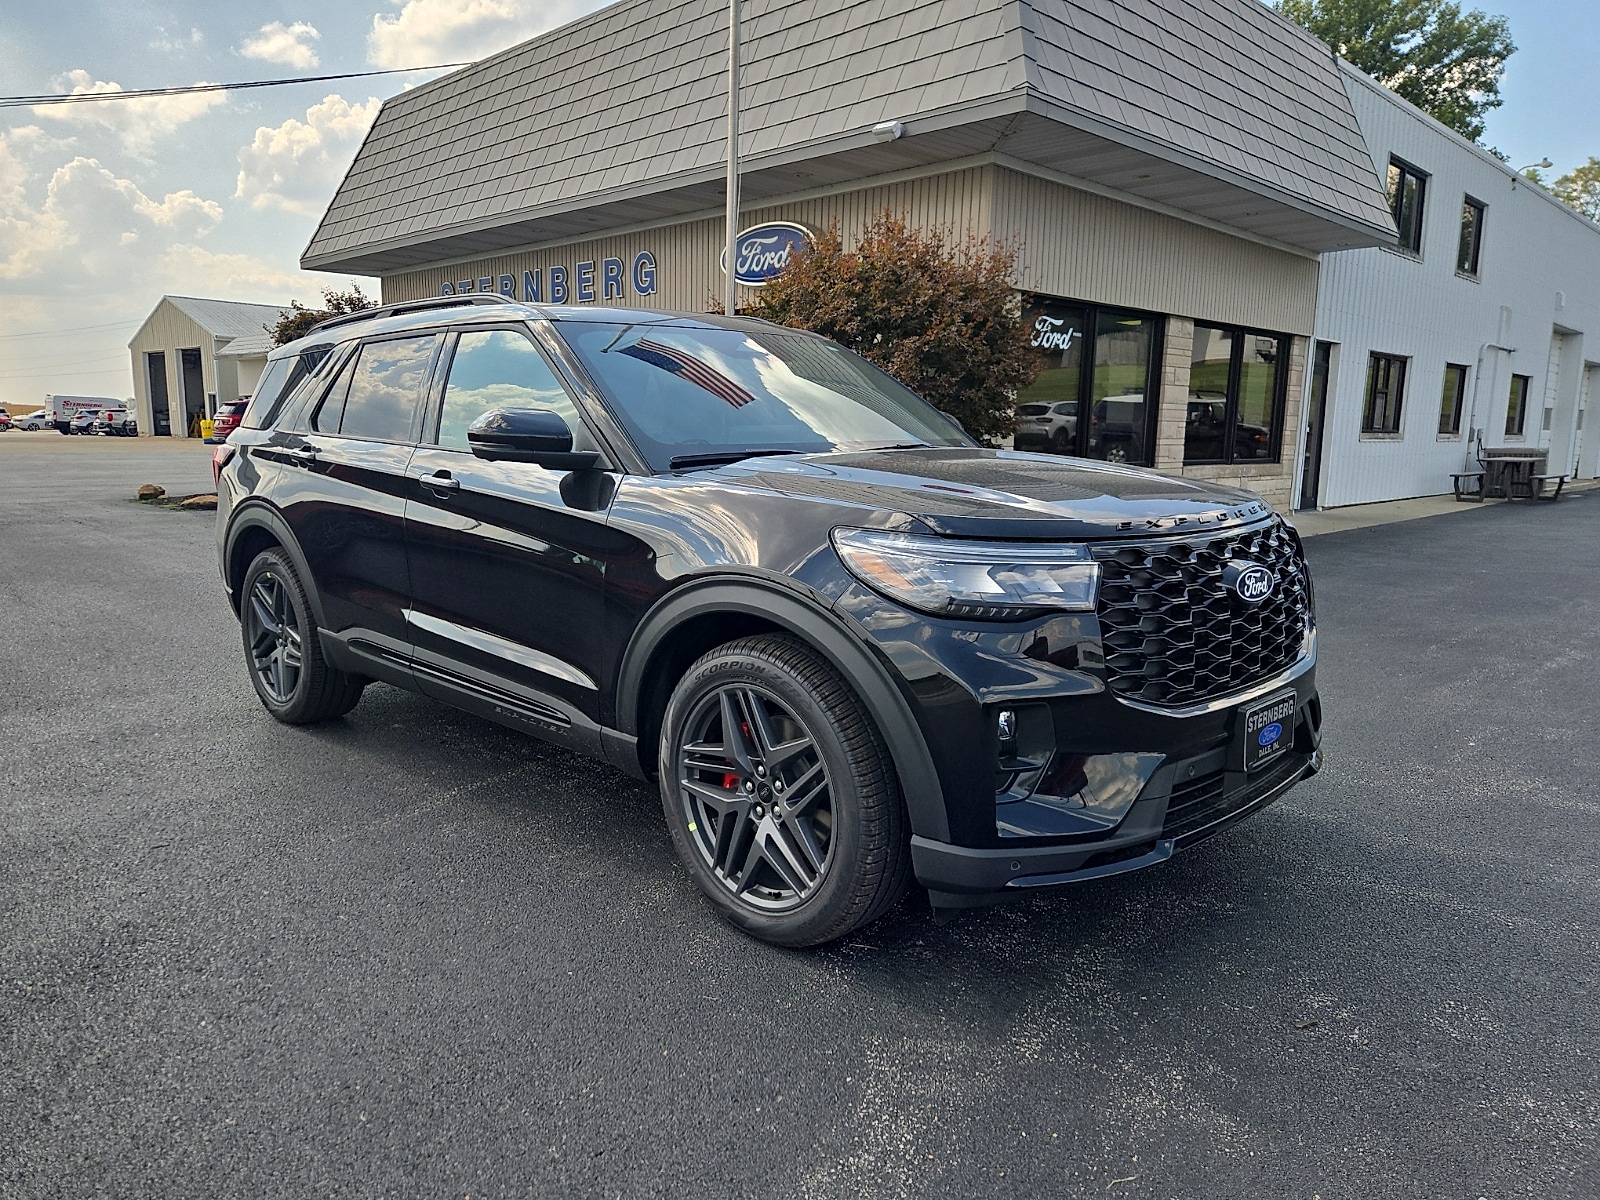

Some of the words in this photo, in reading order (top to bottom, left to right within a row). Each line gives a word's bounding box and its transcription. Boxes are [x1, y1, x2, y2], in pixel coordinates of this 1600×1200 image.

[736, 235, 791, 275] Ford
[1031, 315, 1073, 350] Ford
[1116, 503, 1267, 531] EXPLORER
[1244, 571, 1269, 597] Ford
[694, 661, 766, 684] SCORPION
[1247, 699, 1294, 733] STERNBERG
